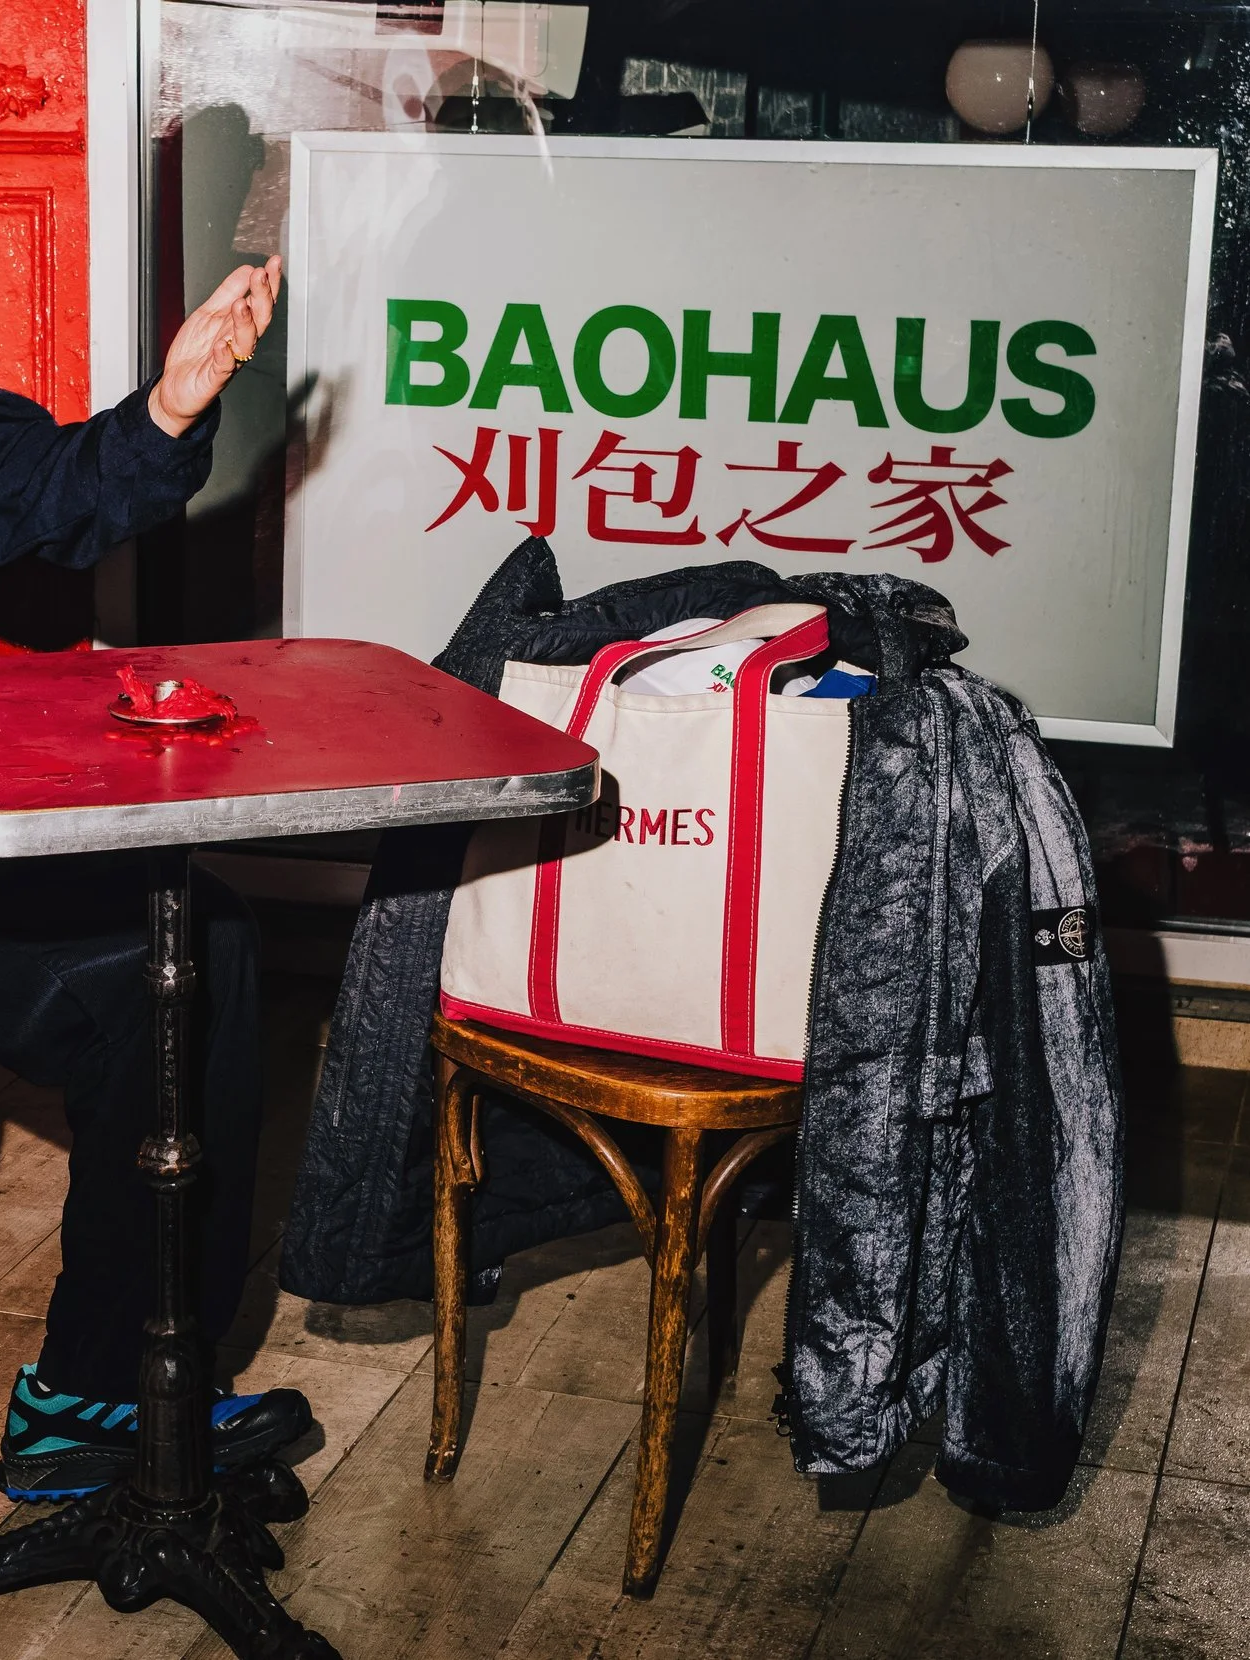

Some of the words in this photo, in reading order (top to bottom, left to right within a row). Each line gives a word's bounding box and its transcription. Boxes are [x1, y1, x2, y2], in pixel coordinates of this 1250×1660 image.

[385, 297, 1096, 439] BAOHAUS
[424, 426, 1014, 564] 刈包之家
[575, 802, 717, 847] HERMES
[1061, 913, 1078, 933] STONE
